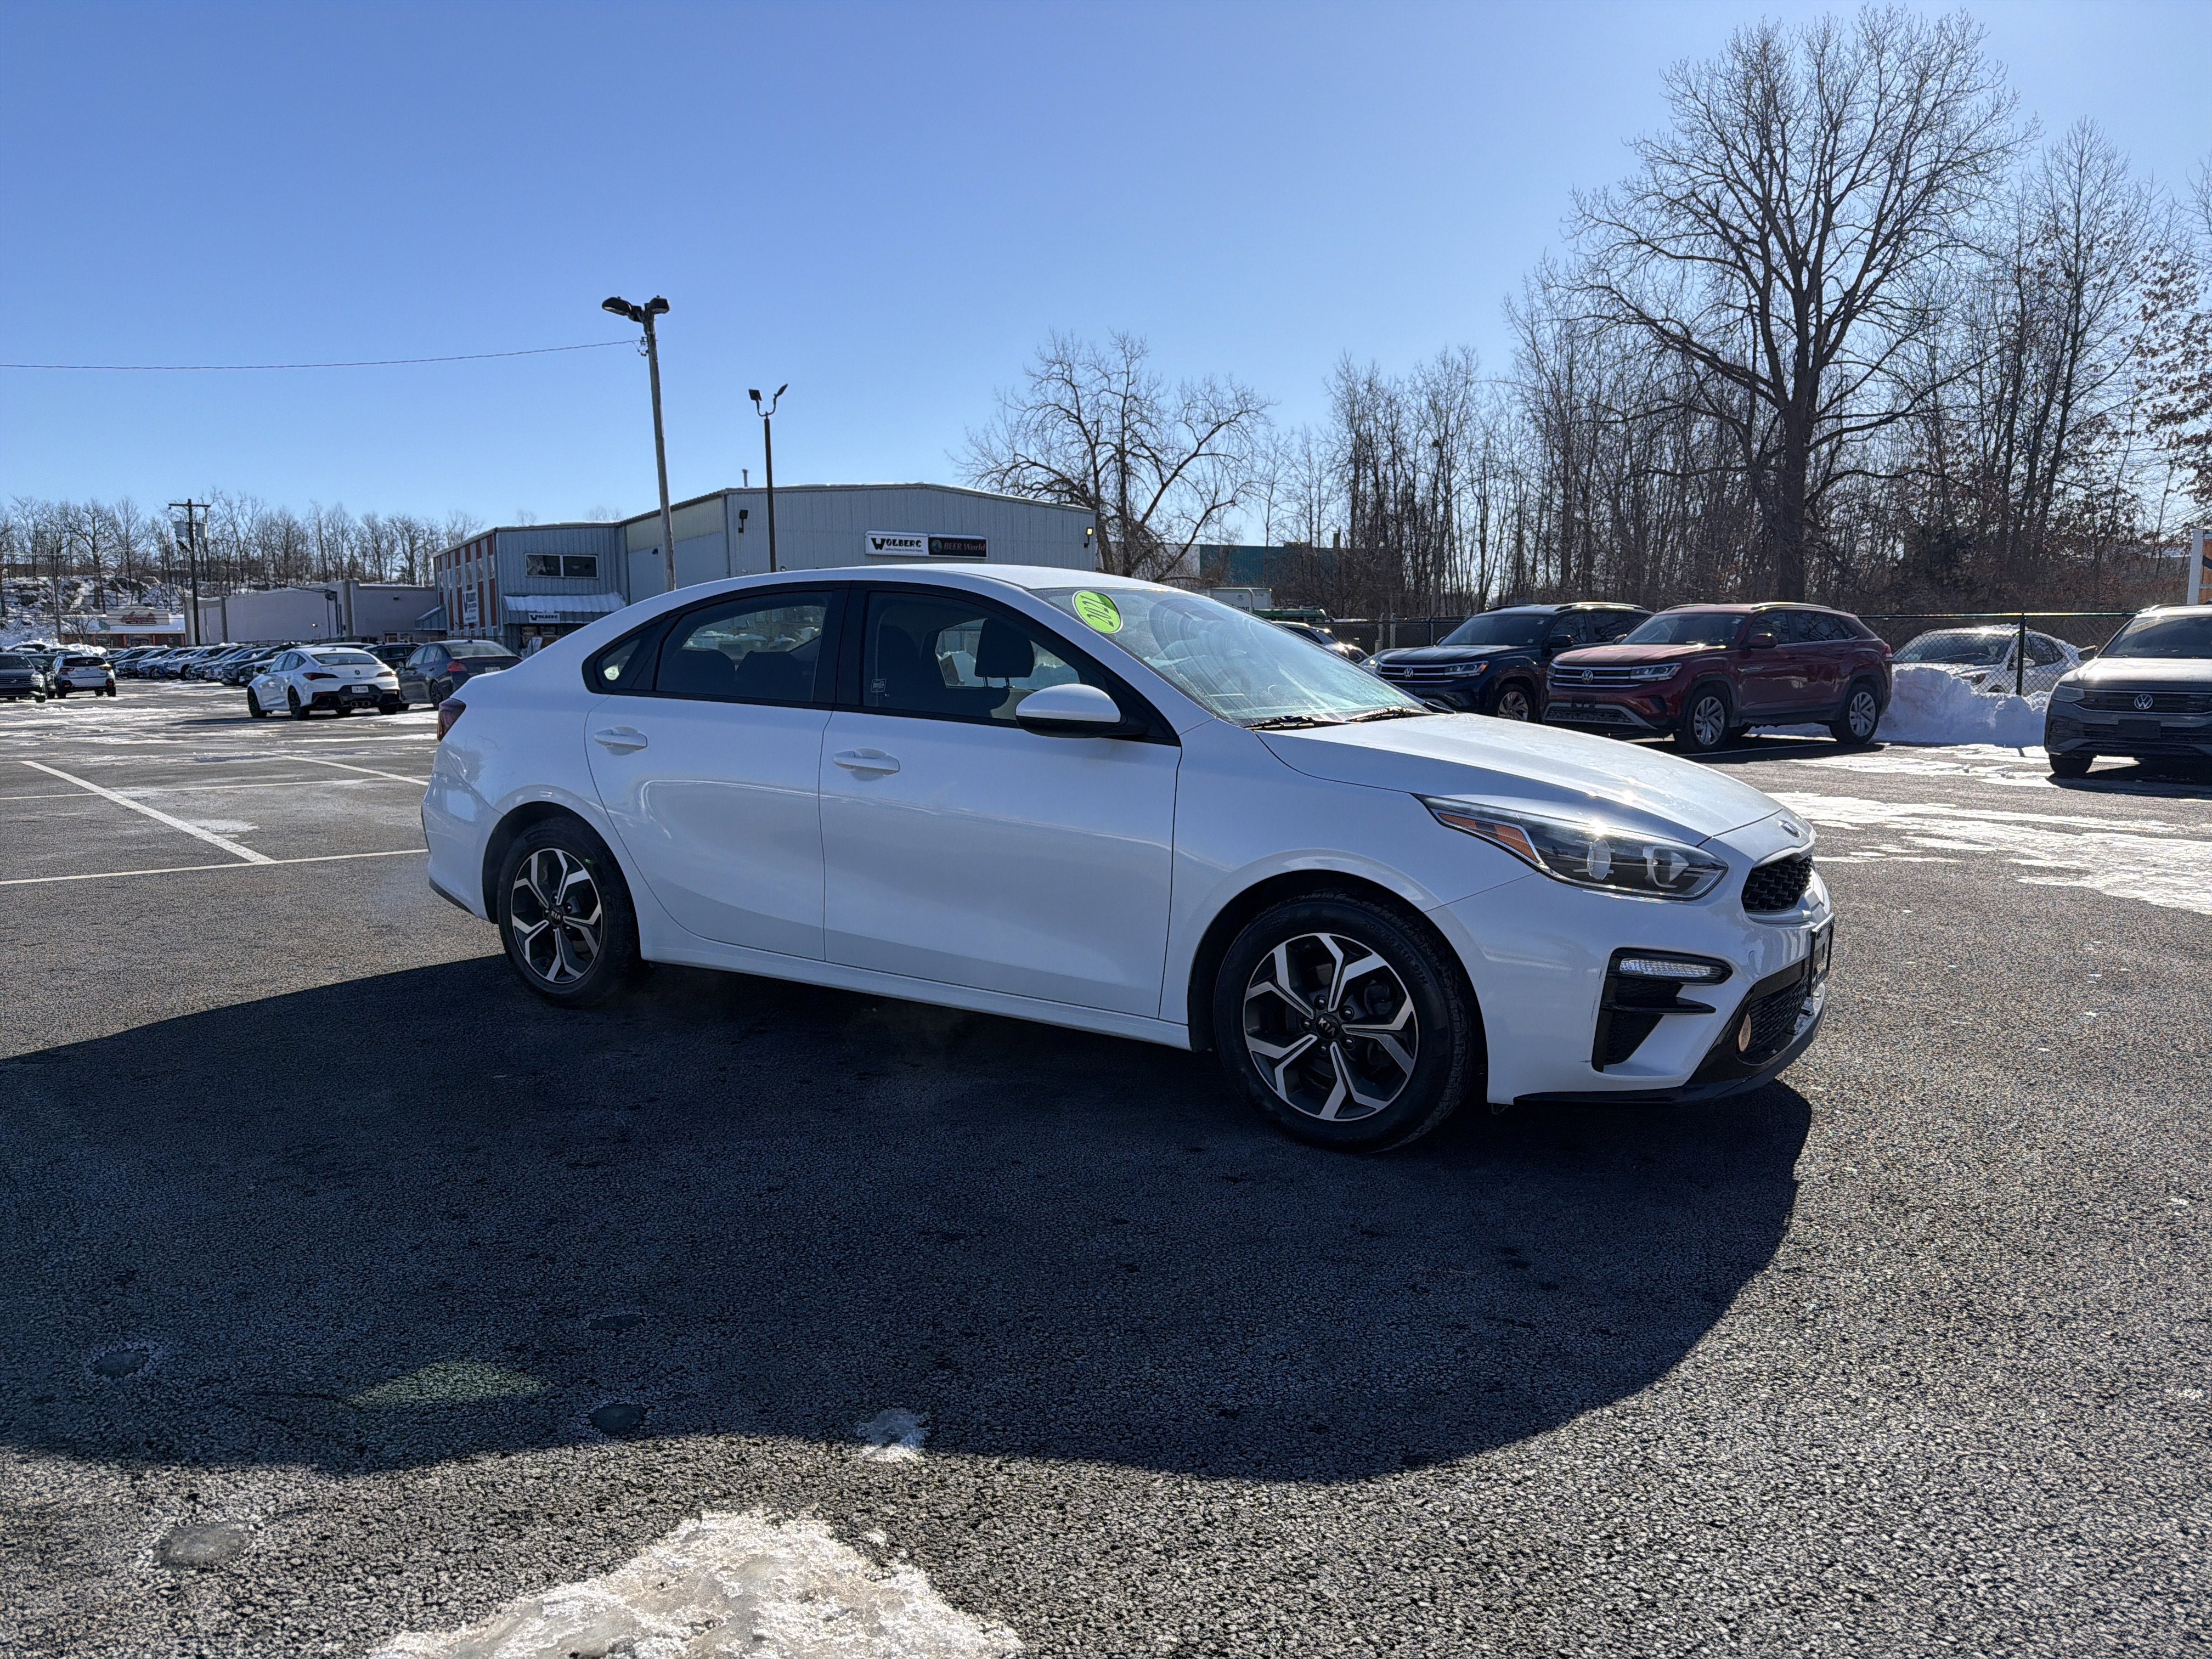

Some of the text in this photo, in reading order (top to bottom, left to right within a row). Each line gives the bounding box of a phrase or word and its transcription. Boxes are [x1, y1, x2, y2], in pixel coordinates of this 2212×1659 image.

[944, 542, 985, 551] BEER World
[551, 910, 561, 921] KIA
[1318, 1017, 1335, 1036] KIA
